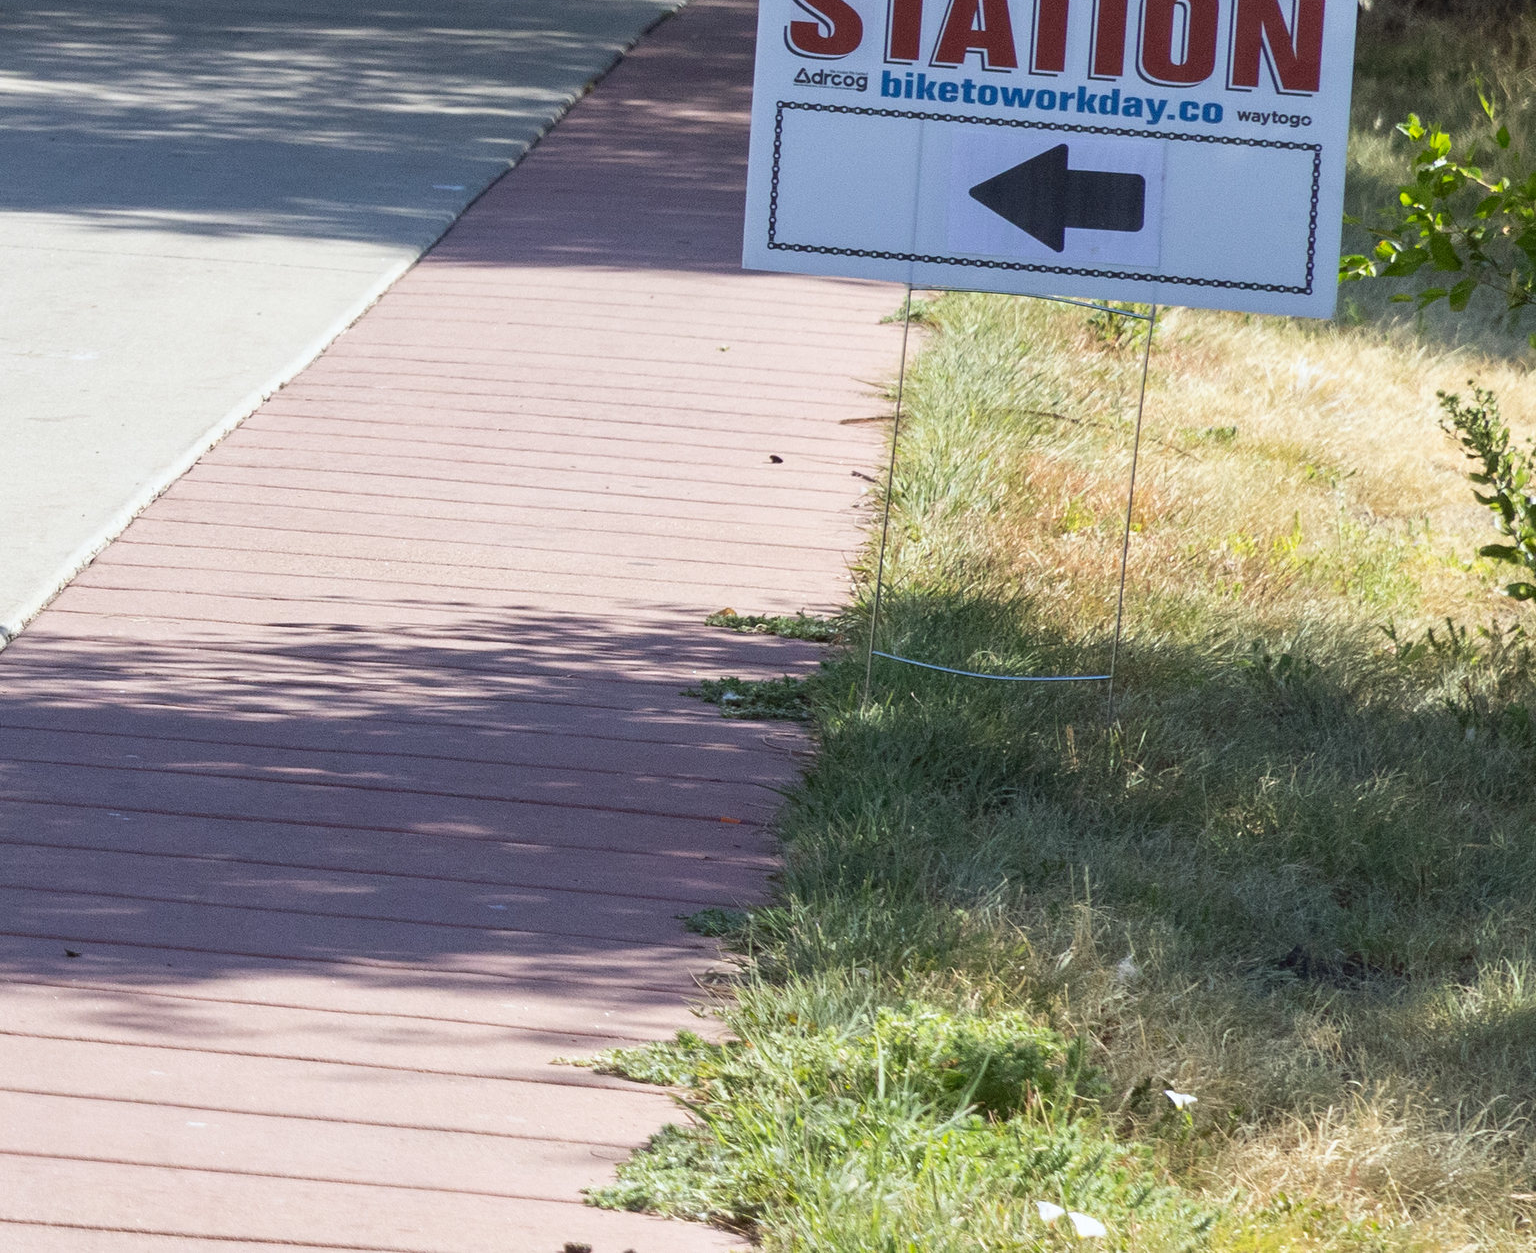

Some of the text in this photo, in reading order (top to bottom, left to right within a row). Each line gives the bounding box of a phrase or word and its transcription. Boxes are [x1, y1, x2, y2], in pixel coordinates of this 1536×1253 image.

[812, 69, 868, 92] drcog
[880, 71, 1224, 125] biketoworkday.co
[1237, 111, 1312, 128] waytogo
